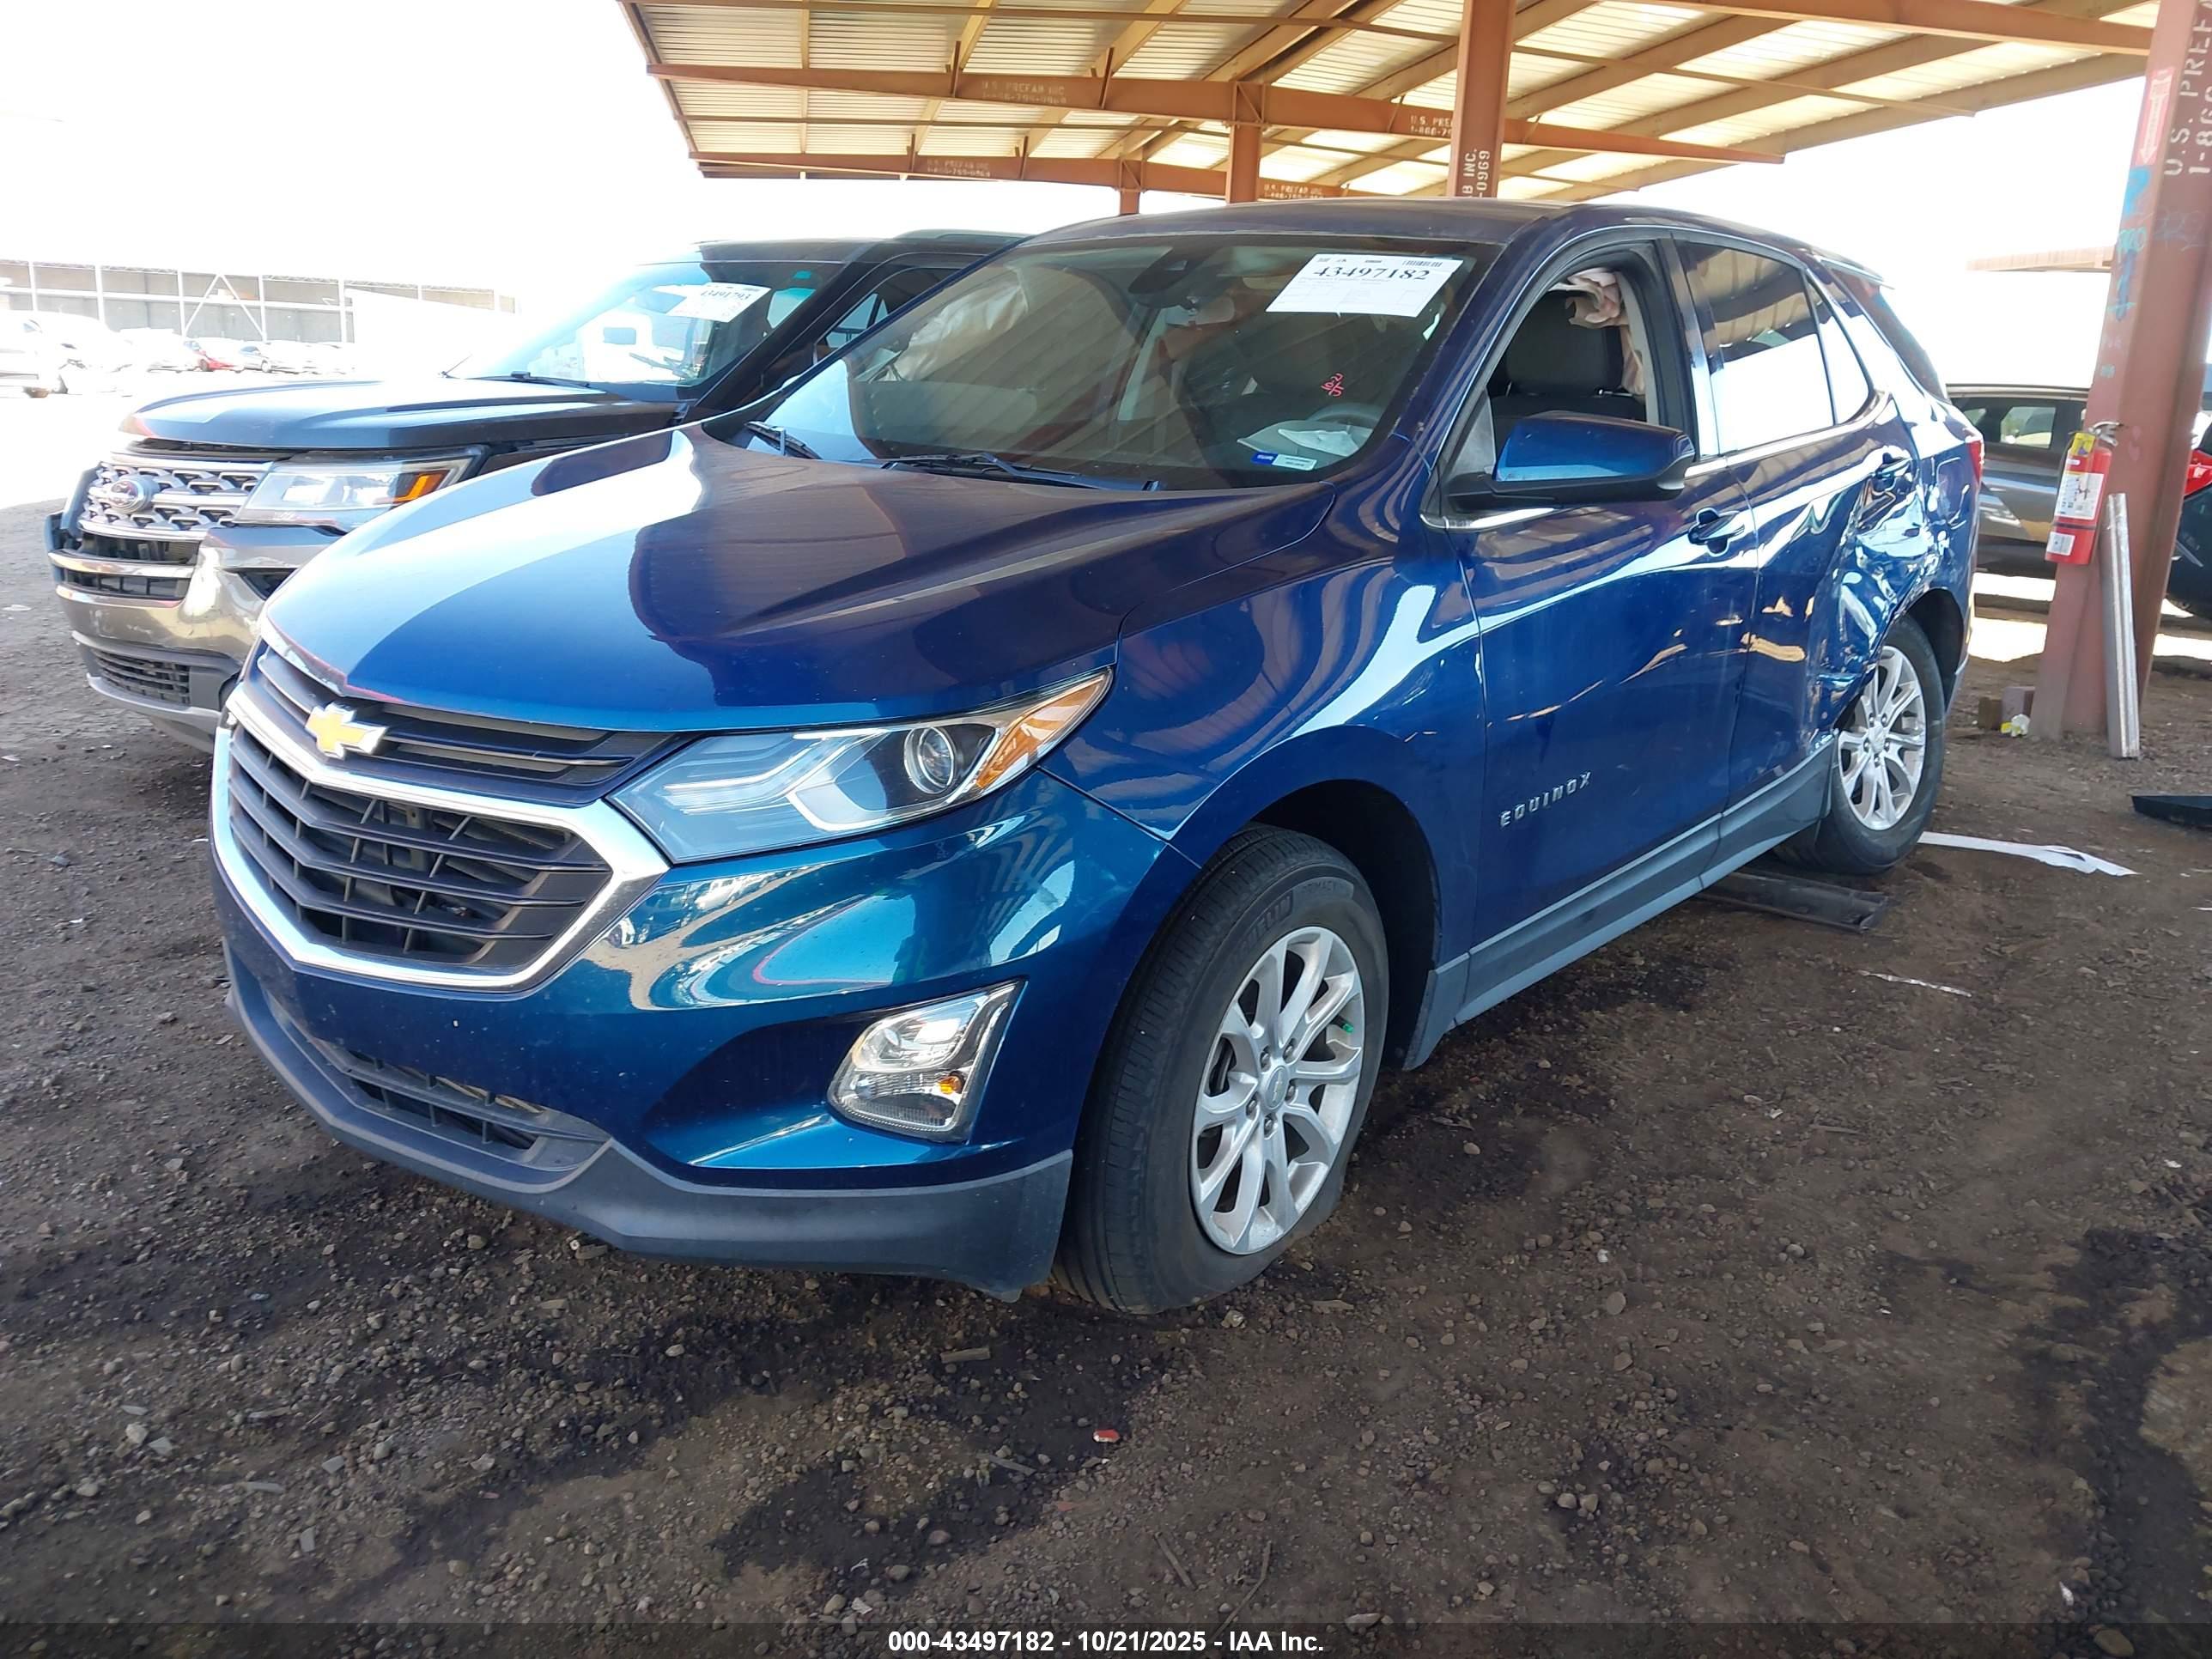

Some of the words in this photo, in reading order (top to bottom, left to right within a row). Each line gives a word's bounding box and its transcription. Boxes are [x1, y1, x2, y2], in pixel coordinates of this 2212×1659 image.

[1432, 117, 1453, 128] PRE
[2163, 118, 2193, 175] U.S.
[1462, 148, 1478, 177] INC.
[1314, 266, 1430, 280] 43497182
[1500, 771, 1591, 828] EQUINOX
